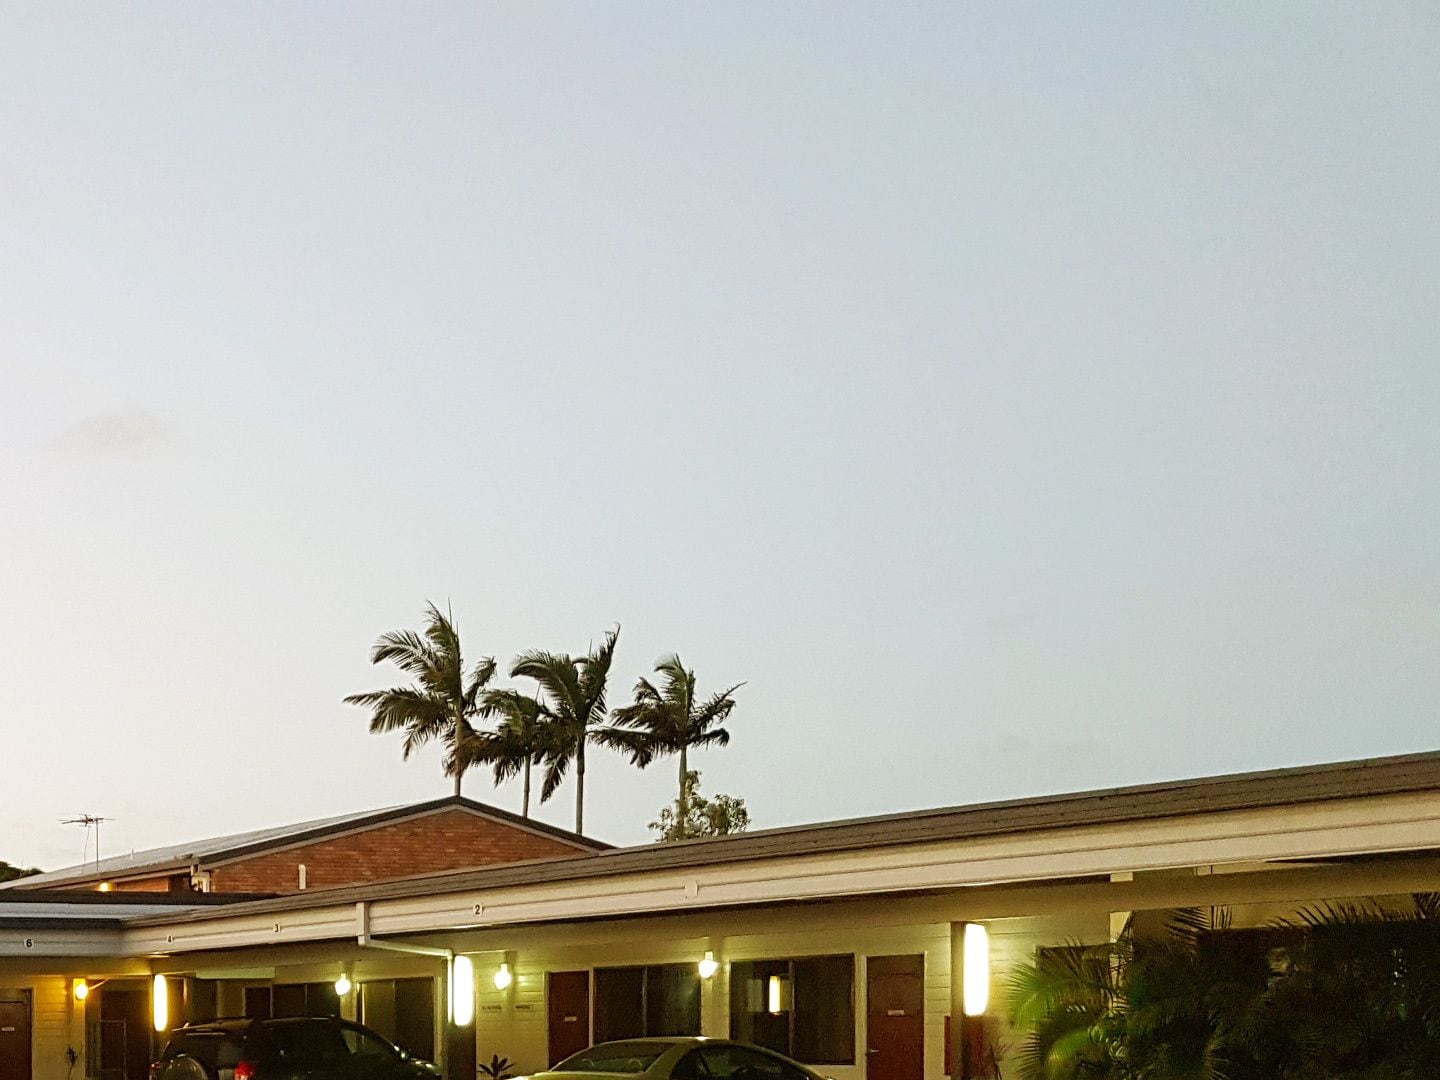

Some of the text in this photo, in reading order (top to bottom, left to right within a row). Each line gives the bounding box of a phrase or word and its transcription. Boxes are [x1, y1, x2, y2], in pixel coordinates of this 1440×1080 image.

[475, 904, 481, 915] 2
[274, 924, 279, 933] 3
[26, 938, 33, 948] 6
